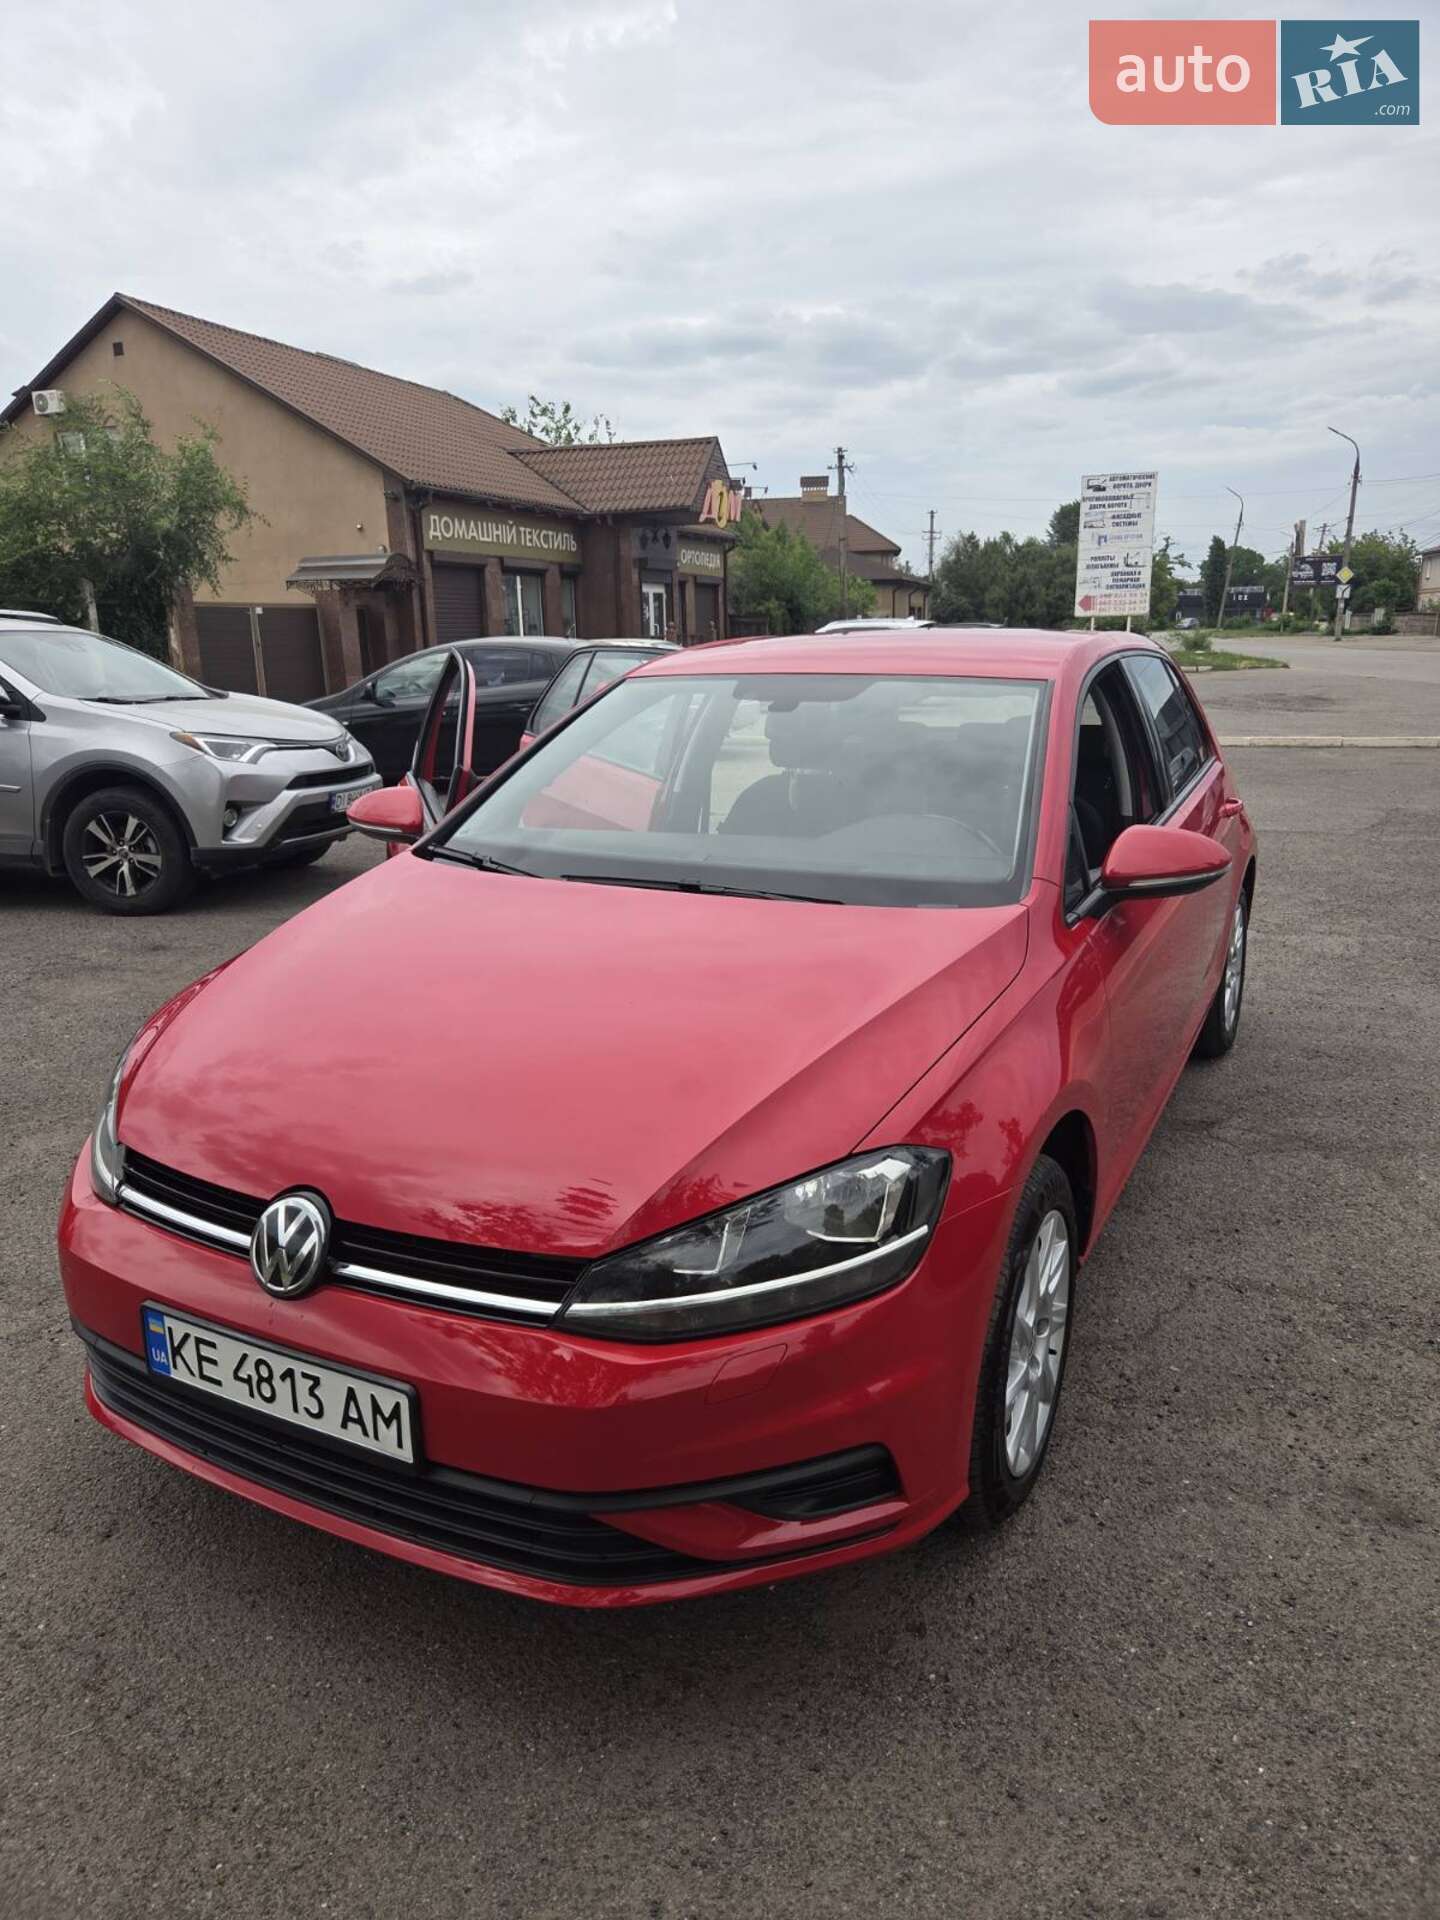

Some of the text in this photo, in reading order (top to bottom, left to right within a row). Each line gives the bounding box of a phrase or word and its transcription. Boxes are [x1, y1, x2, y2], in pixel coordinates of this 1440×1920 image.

[429, 514, 577, 552] ДОМАШНІЙ ТЕКСТИЛЬ
[152, 1347, 169, 1366] UA
[167, 1326, 404, 1450] KE 4813 AM
